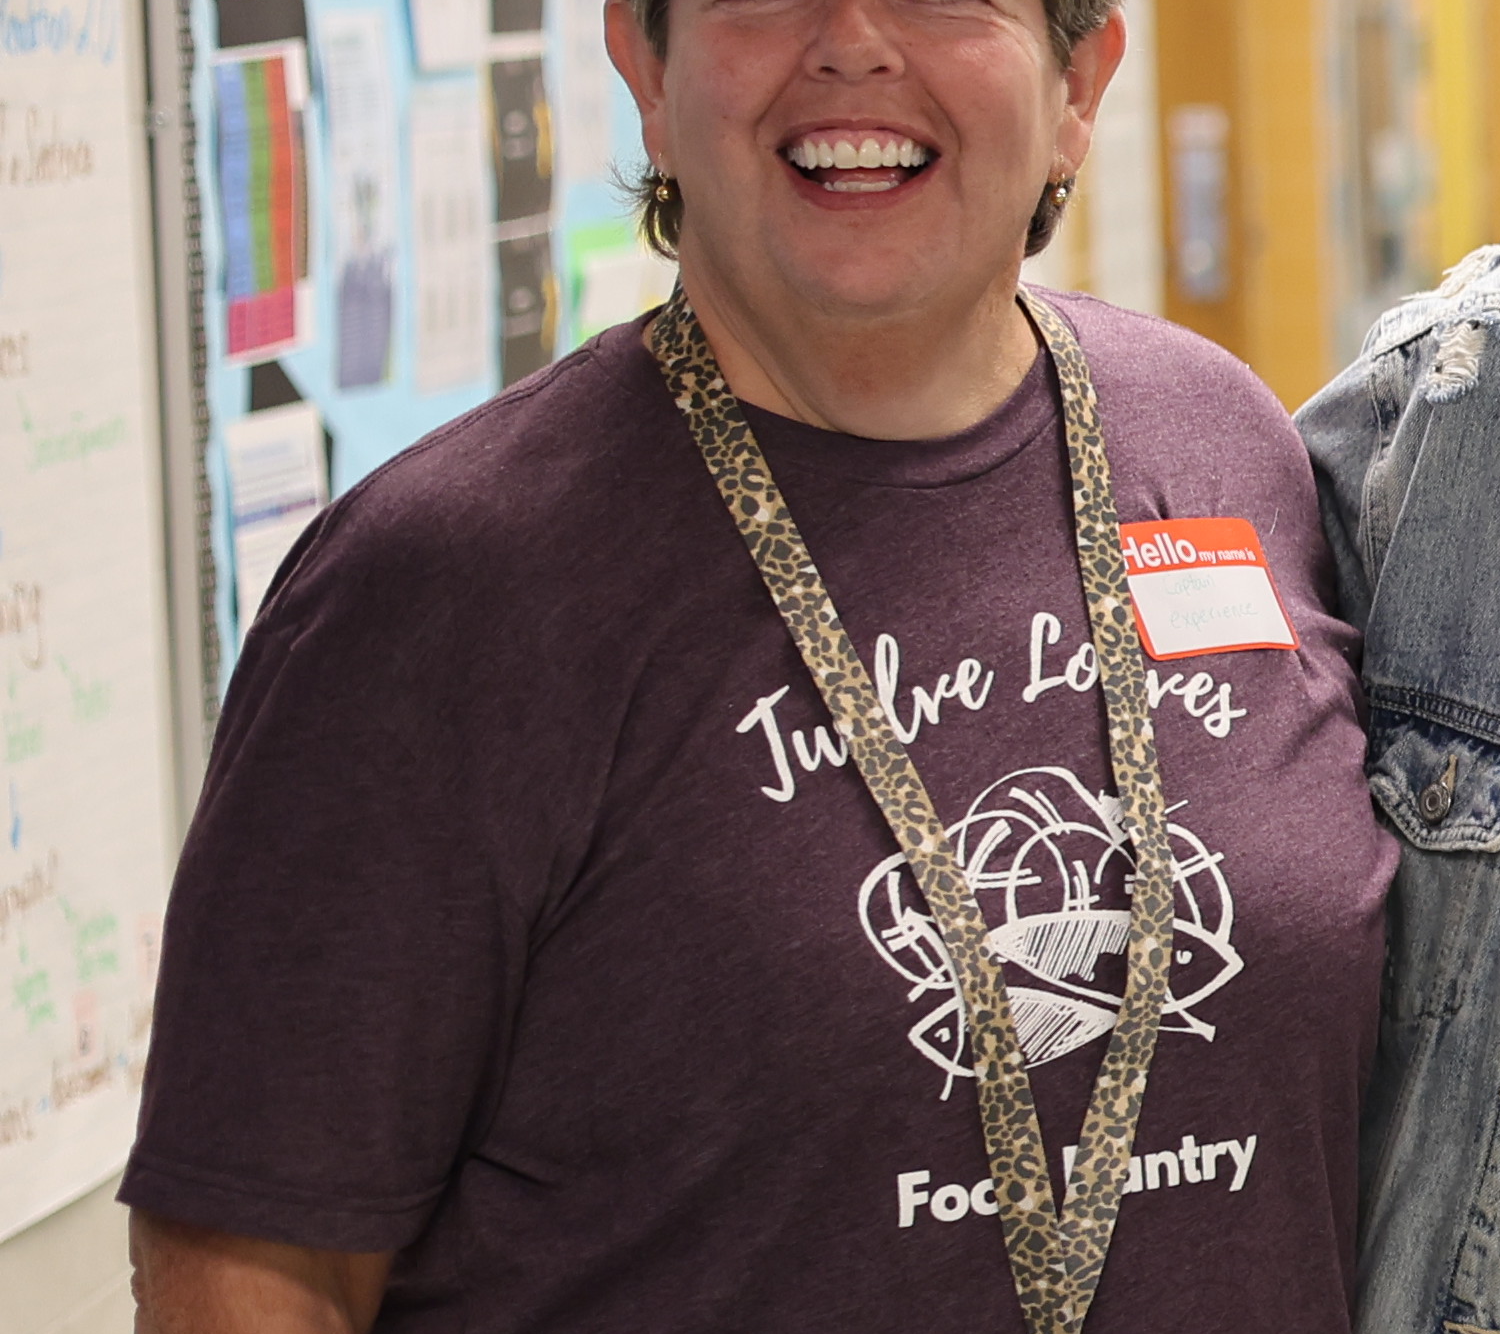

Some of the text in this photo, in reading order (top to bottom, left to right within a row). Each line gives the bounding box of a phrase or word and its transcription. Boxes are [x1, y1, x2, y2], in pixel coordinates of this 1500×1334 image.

[1122, 532, 1256, 570] Hello my name is
[1022, 612, 1246, 738] Loves
